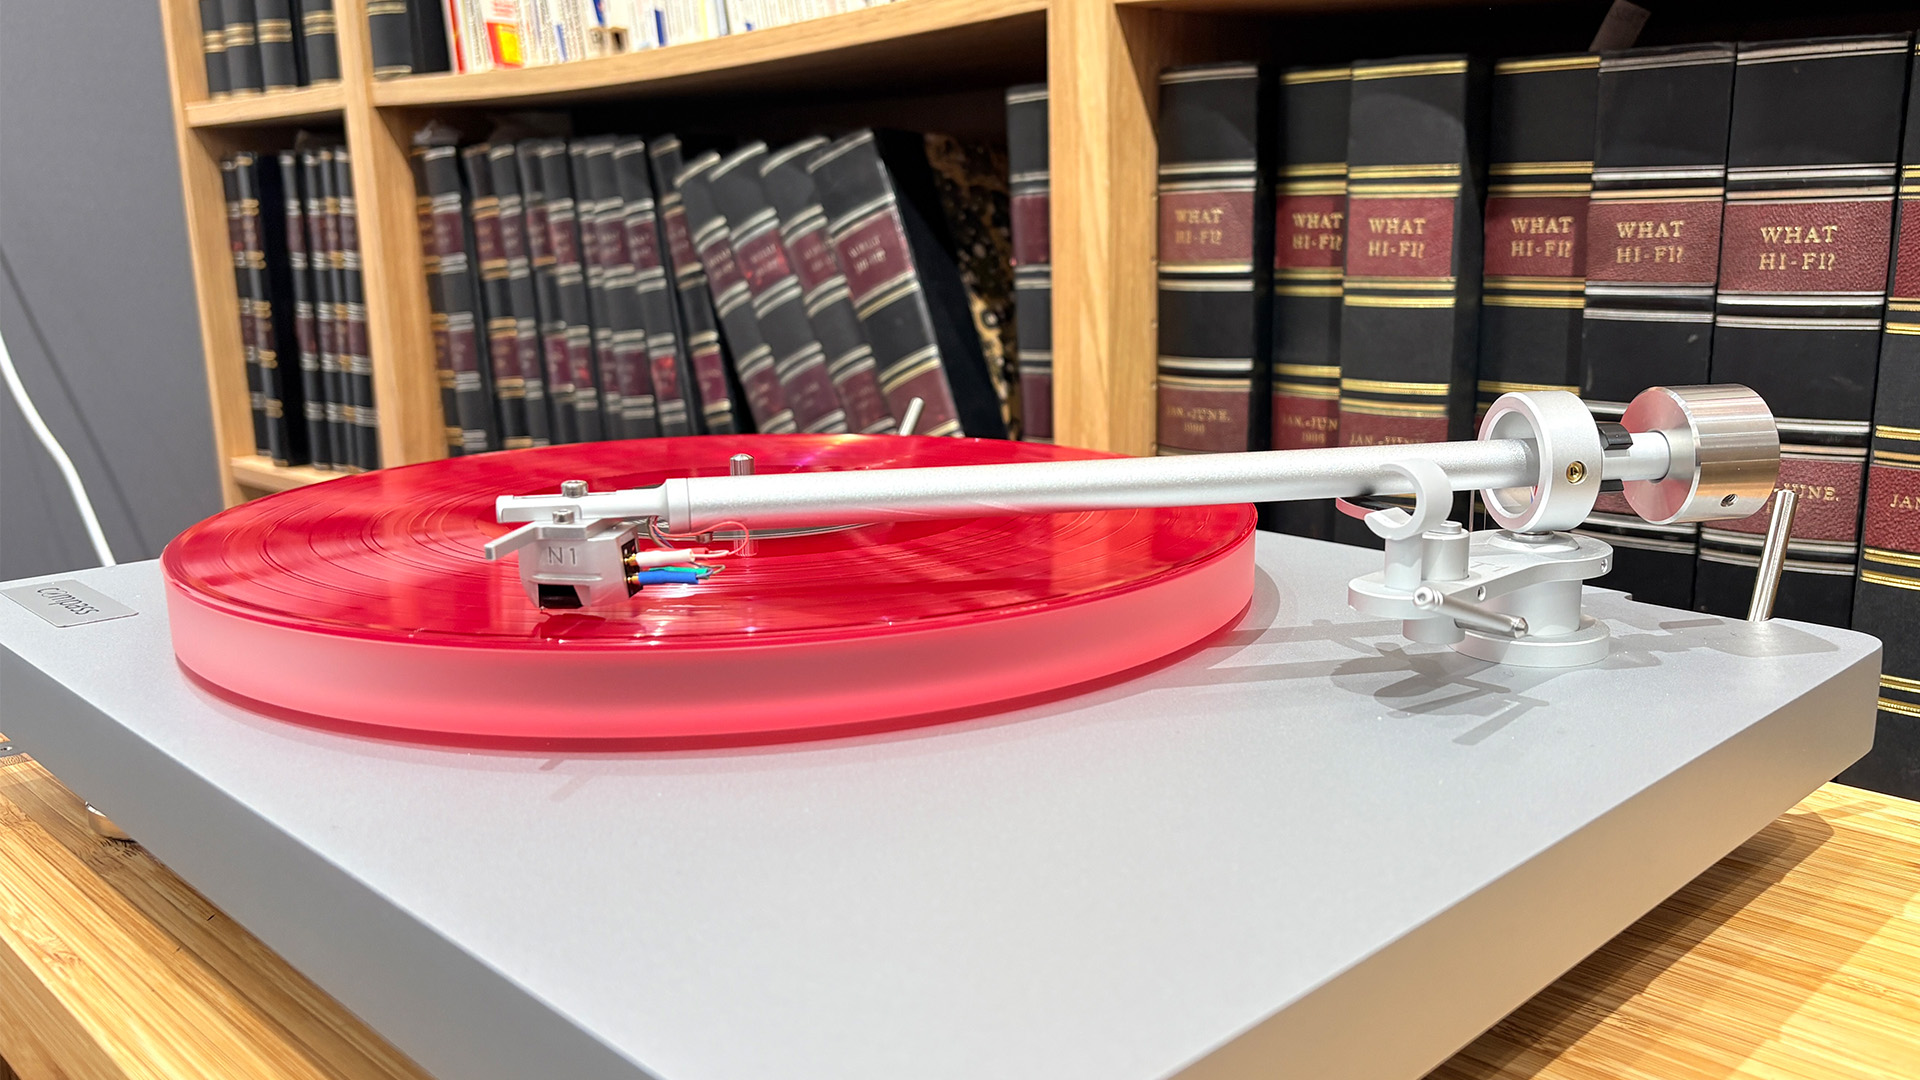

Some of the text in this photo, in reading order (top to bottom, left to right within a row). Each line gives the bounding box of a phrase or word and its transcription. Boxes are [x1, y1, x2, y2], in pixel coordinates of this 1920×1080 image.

[1175, 208, 1224, 224] WHAT
[1292, 212, 1344, 229] WHAT
[1511, 216, 1574, 234] WHAT
[1368, 217, 1426, 235] WHAT
[1616, 220, 1685, 239] WHAT
[1760, 225, 1838, 244] WHAT
[1368, 240, 1425, 259] HI-FI?
[1511, 239, 1573, 258] HI-FI?
[1616, 245, 1684, 264] HI-FI?
[1759, 252, 1836, 271] HI-FI?
[548, 545, 577, 565] N1
